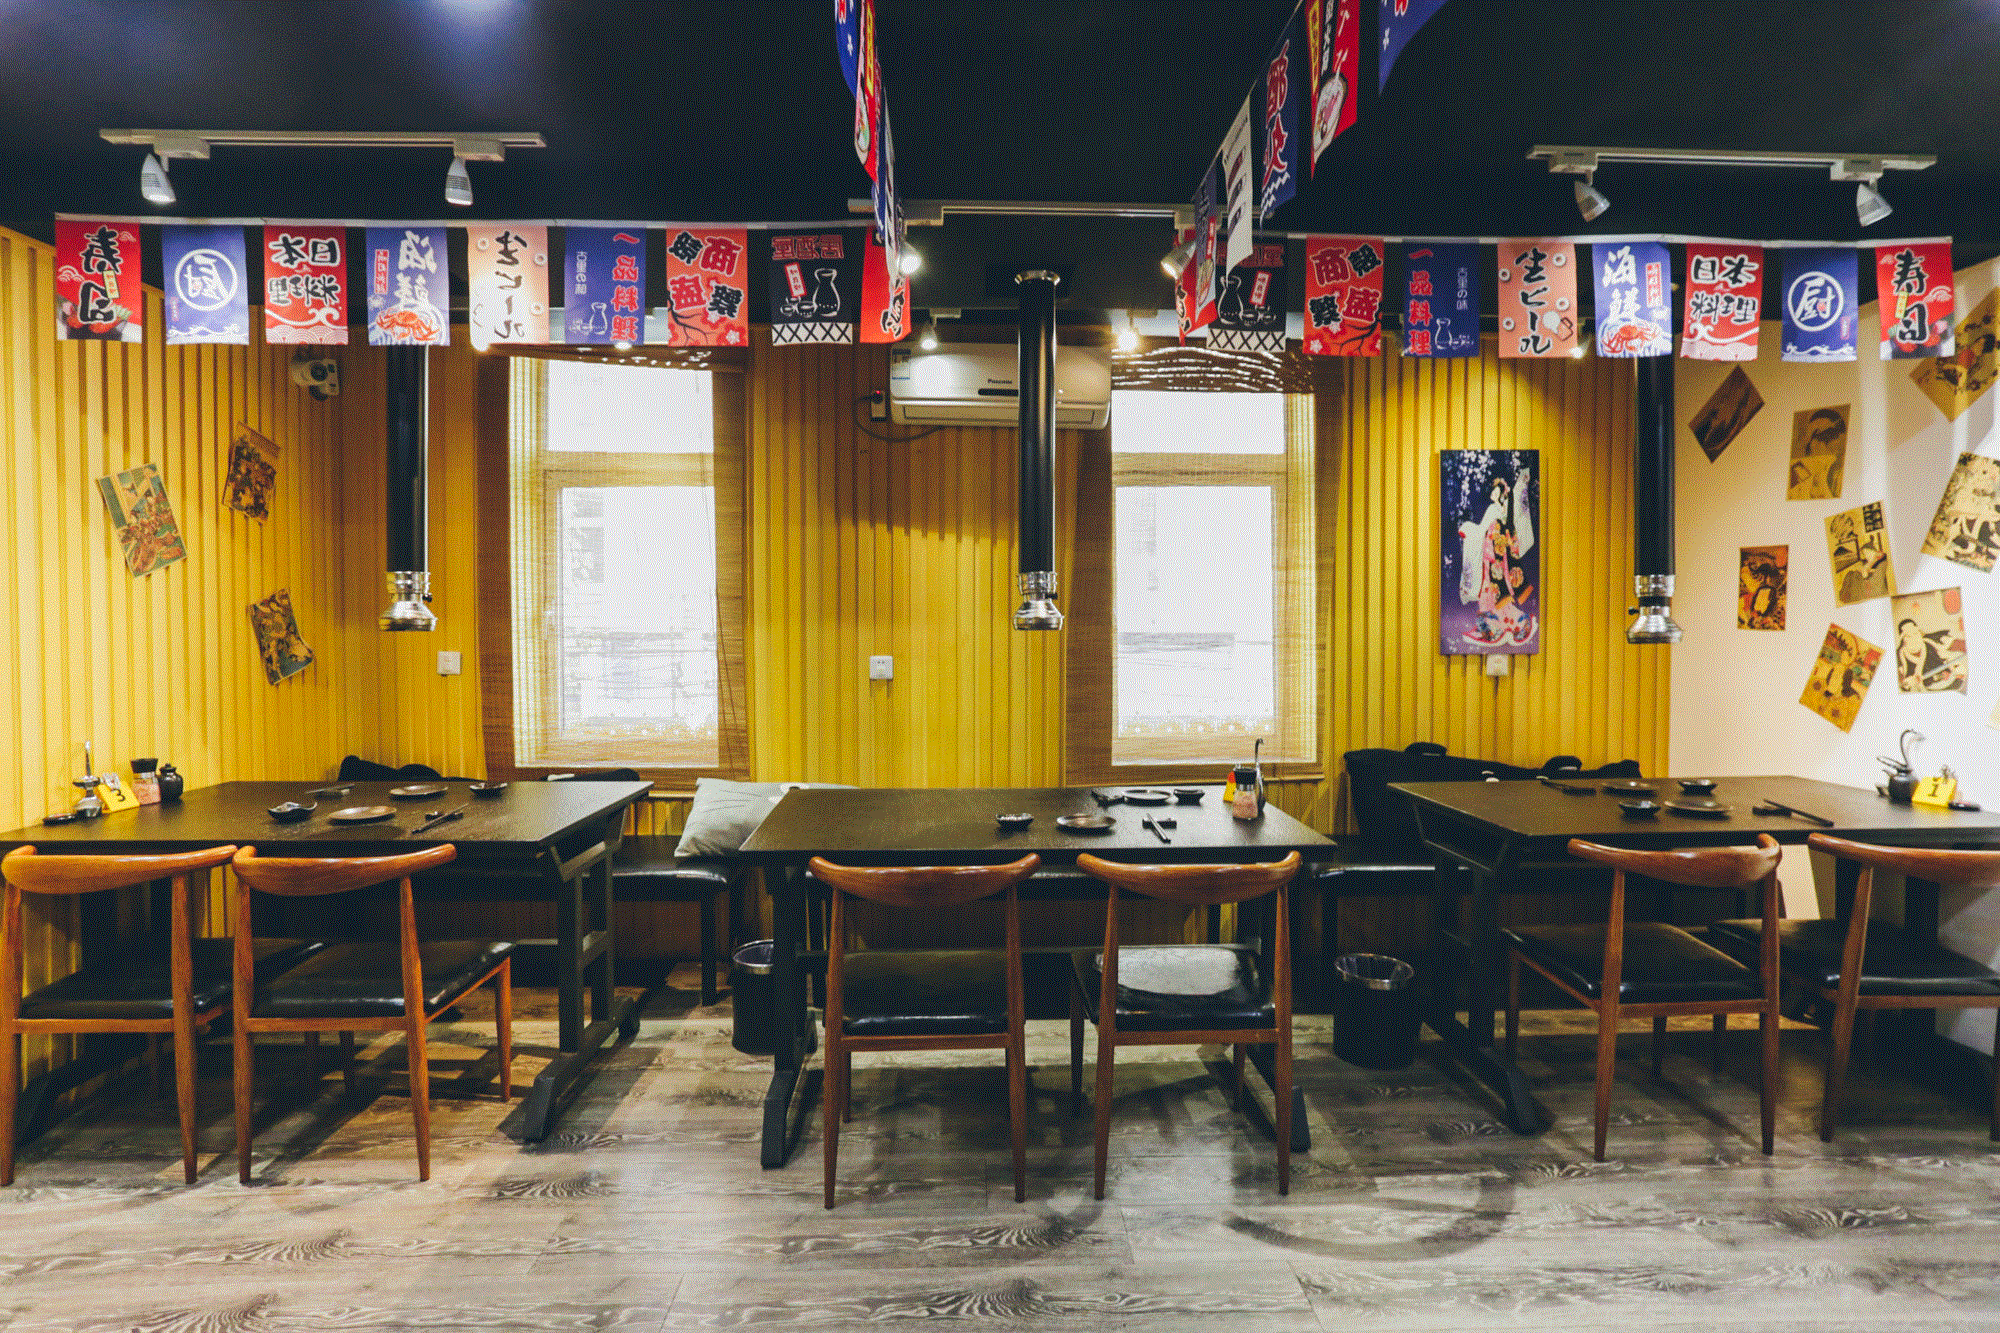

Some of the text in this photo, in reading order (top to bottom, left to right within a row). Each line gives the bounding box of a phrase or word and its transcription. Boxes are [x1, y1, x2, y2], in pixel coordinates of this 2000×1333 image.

[1691, 254, 1759, 288] 日本
[1408, 248, 1434, 355] 一品料理
[1690, 291, 1758, 325] 料理
[1893, 249, 1929, 345] 寿司
[110, 788, 126, 802] 3
